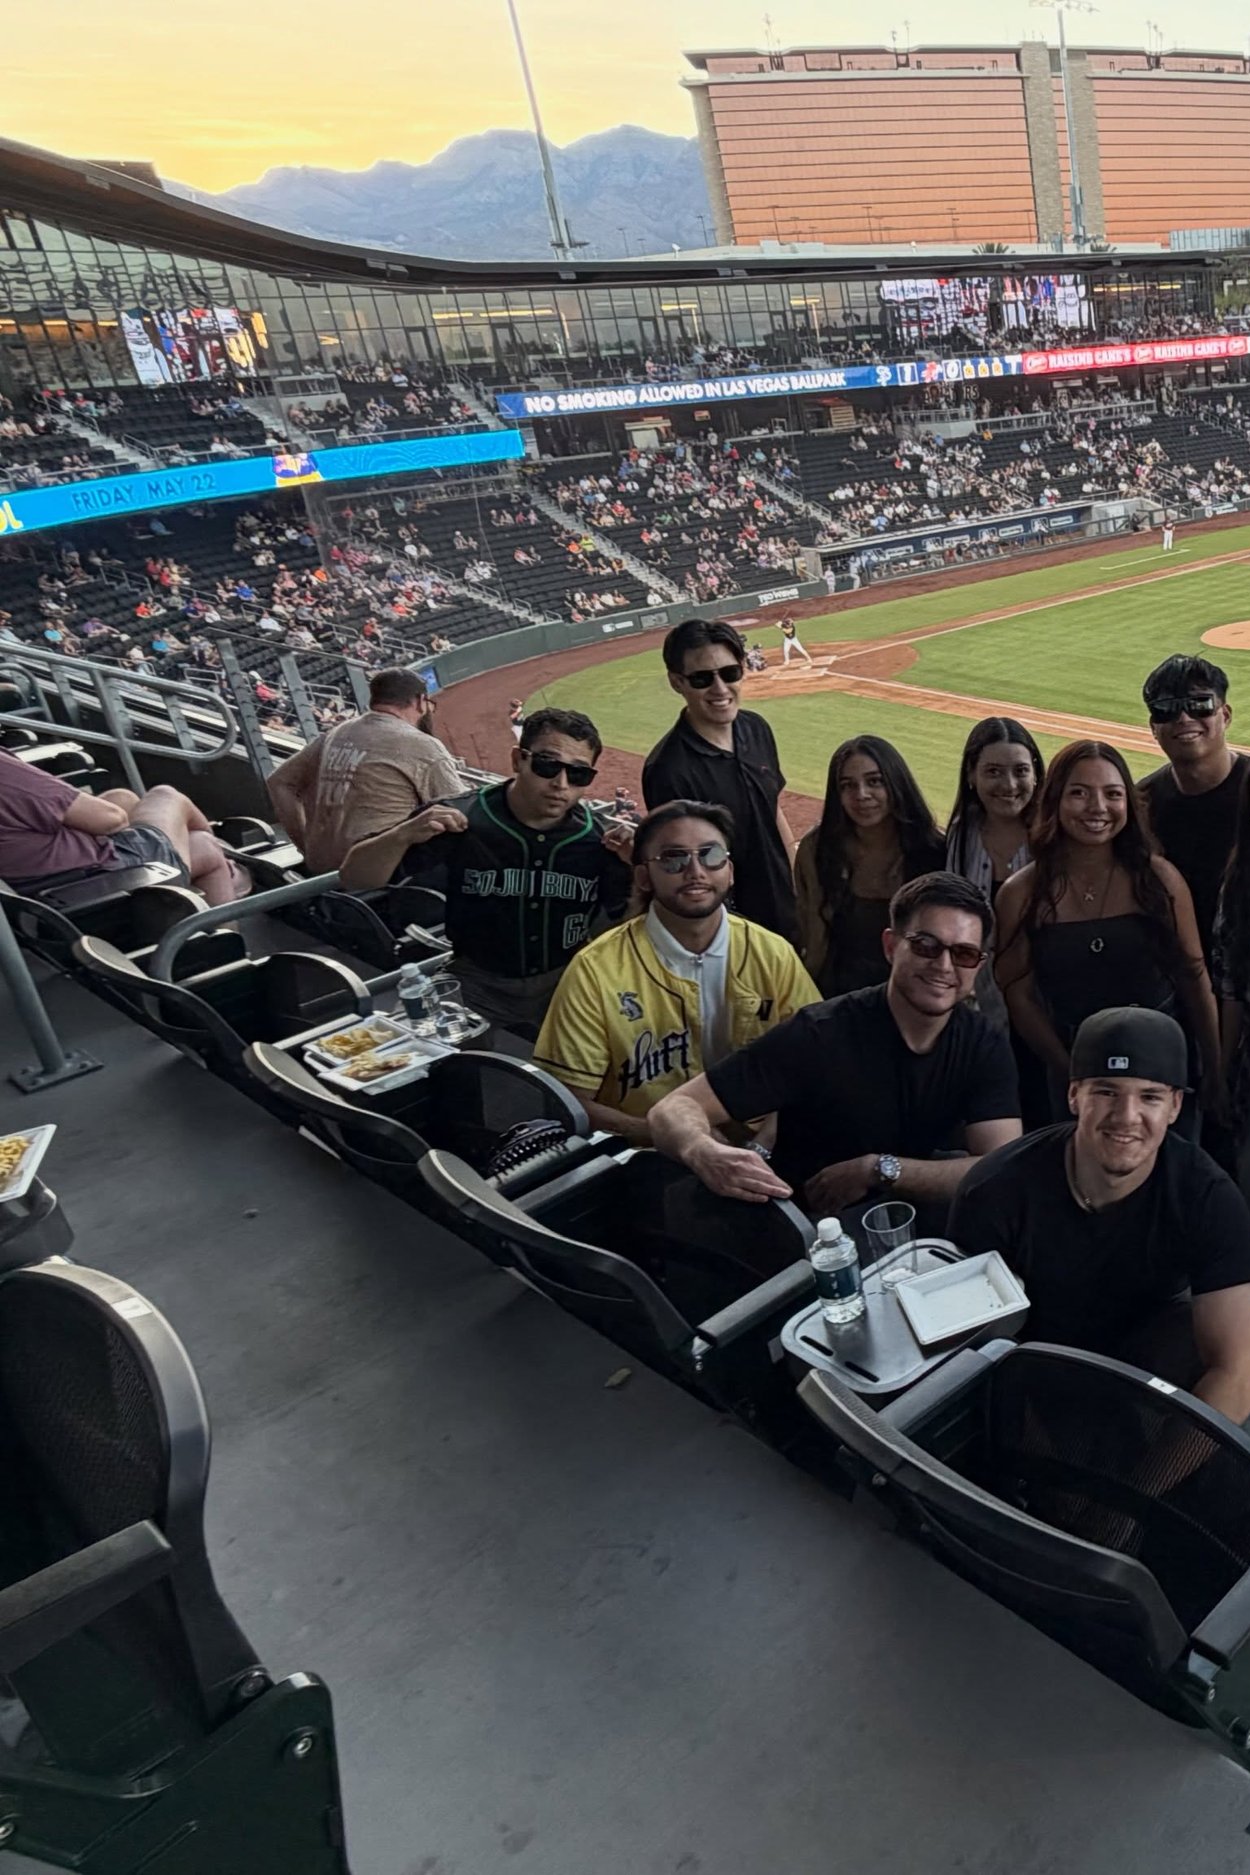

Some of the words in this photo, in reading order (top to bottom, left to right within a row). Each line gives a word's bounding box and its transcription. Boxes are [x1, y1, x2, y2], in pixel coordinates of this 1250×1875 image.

[524, 396, 555, 413] NO
[557, 388, 637, 410] SMOKING
[639, 383, 704, 404] ALLOWED
[706, 381, 723, 398] IN
[723, 378, 747, 396] LAS
[747, 375, 790, 394] VEGAS
[789, 371, 847, 391] BALLPARK
[149, 477, 186, 499] MAY
[190, 473, 217, 493] 22
[461, 867, 537, 898] SOJU
